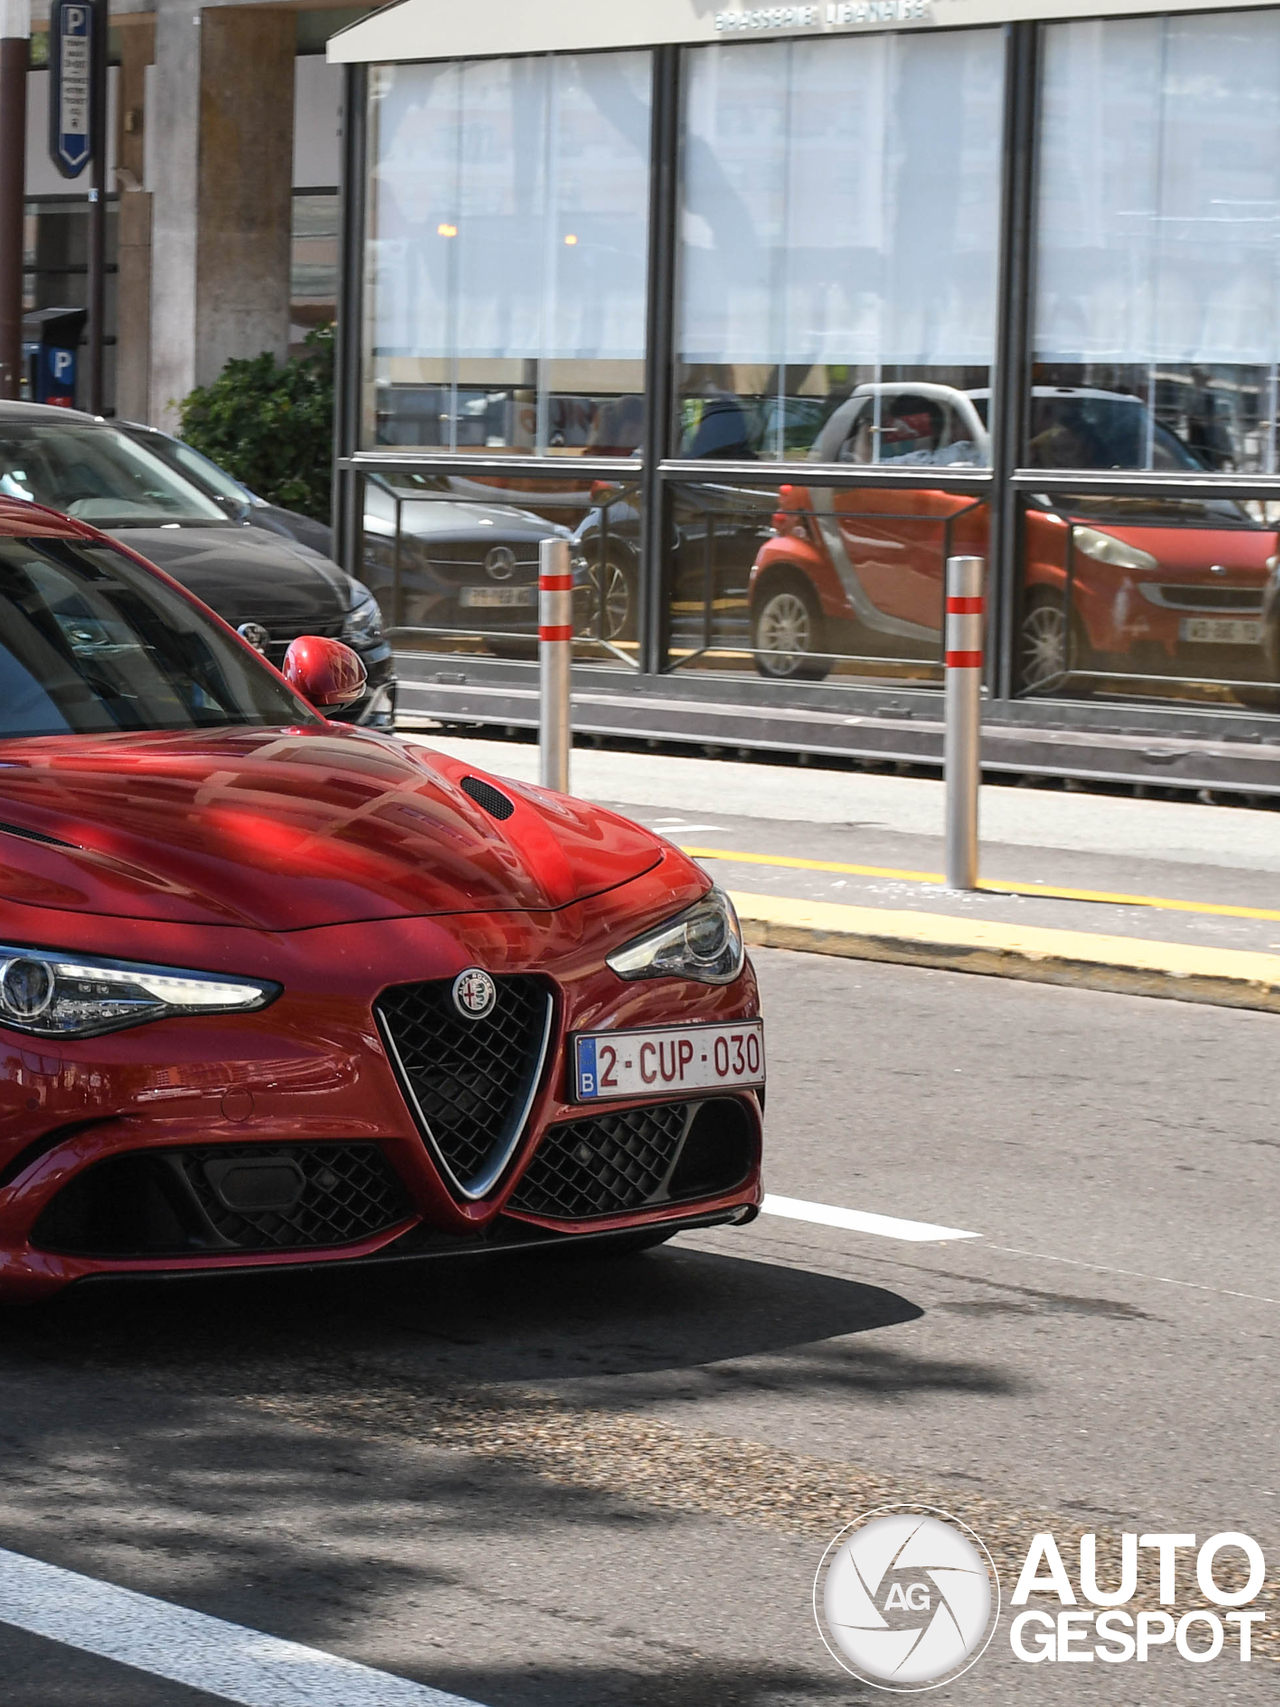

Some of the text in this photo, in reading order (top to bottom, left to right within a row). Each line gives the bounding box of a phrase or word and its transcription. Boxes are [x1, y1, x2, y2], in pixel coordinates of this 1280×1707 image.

[68, 8, 85, 34] P
[715, 1, 927, 31] BRASSERIE LIBANAISE
[54, 351, 72, 378] P
[458, 973, 493, 997] ALFA ROMEO
[599, 1033, 760, 1088] 2-CUP-030
[582, 1073, 595, 1093] B
